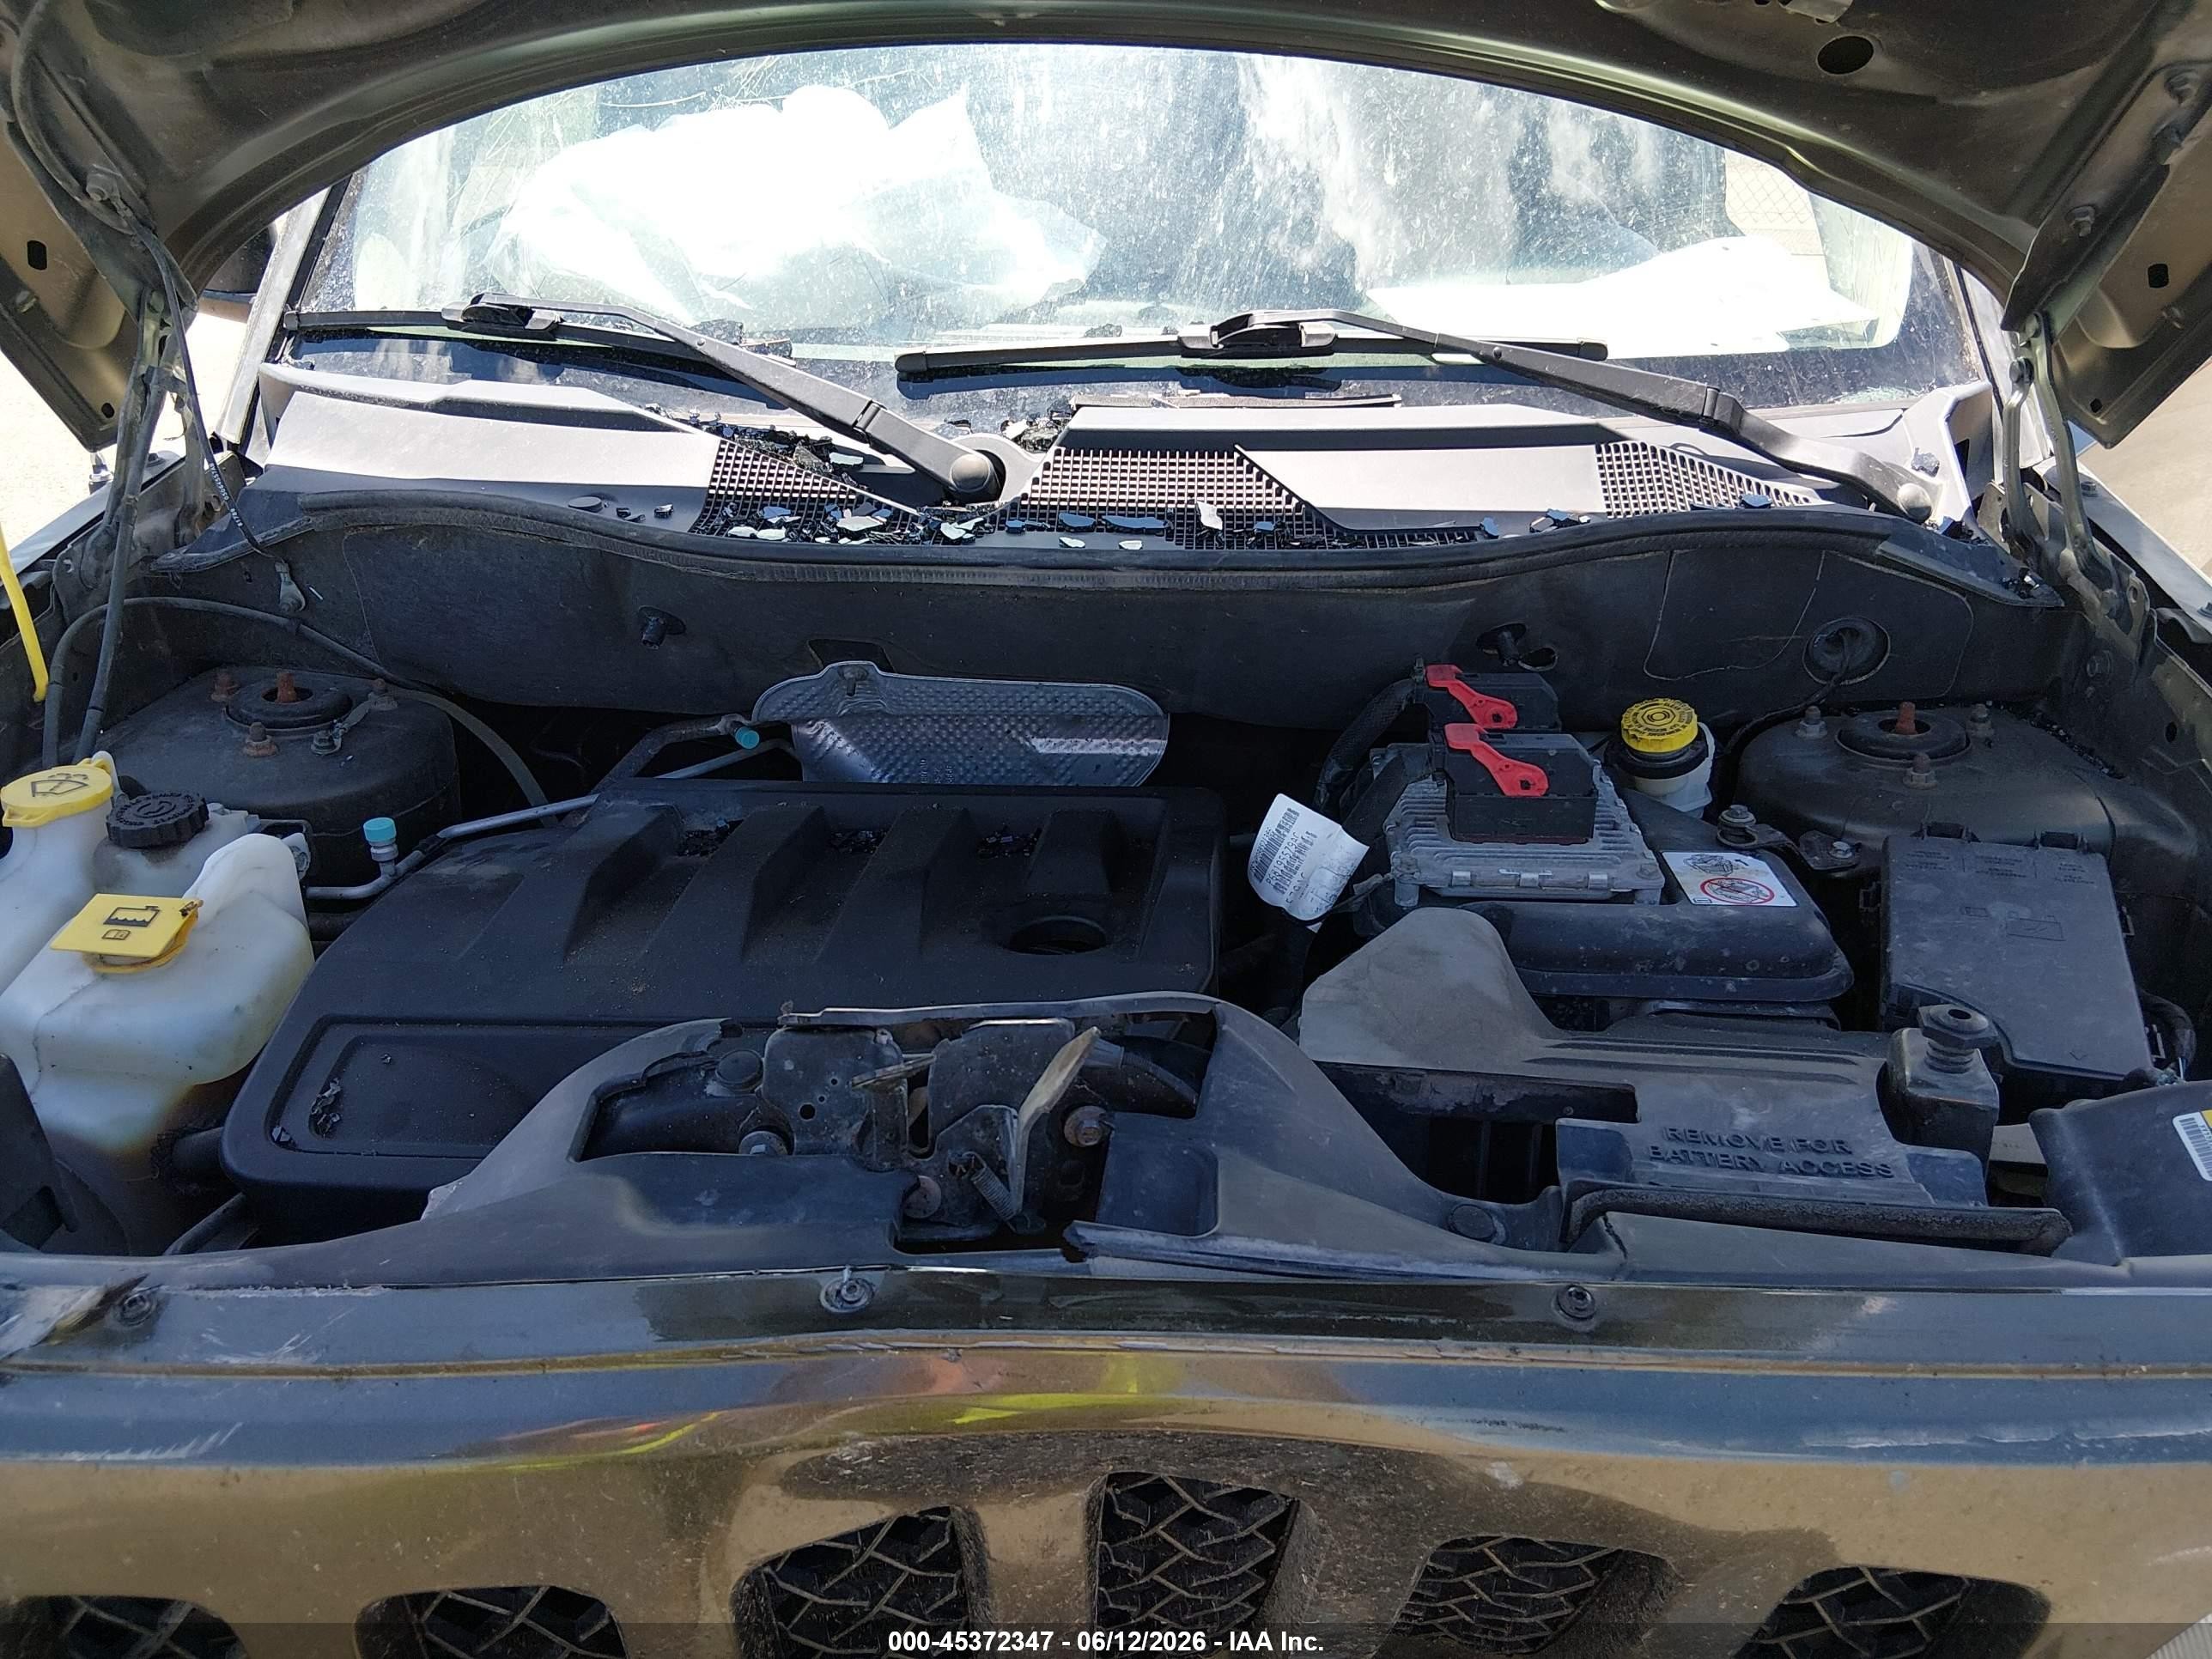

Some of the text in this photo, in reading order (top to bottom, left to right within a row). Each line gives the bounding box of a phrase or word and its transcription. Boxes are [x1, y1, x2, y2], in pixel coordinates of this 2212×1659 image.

[1663, 1127, 1853, 1155] REMOVE FOR
[1649, 1145, 1895, 1179] BATTERY ACCESS
